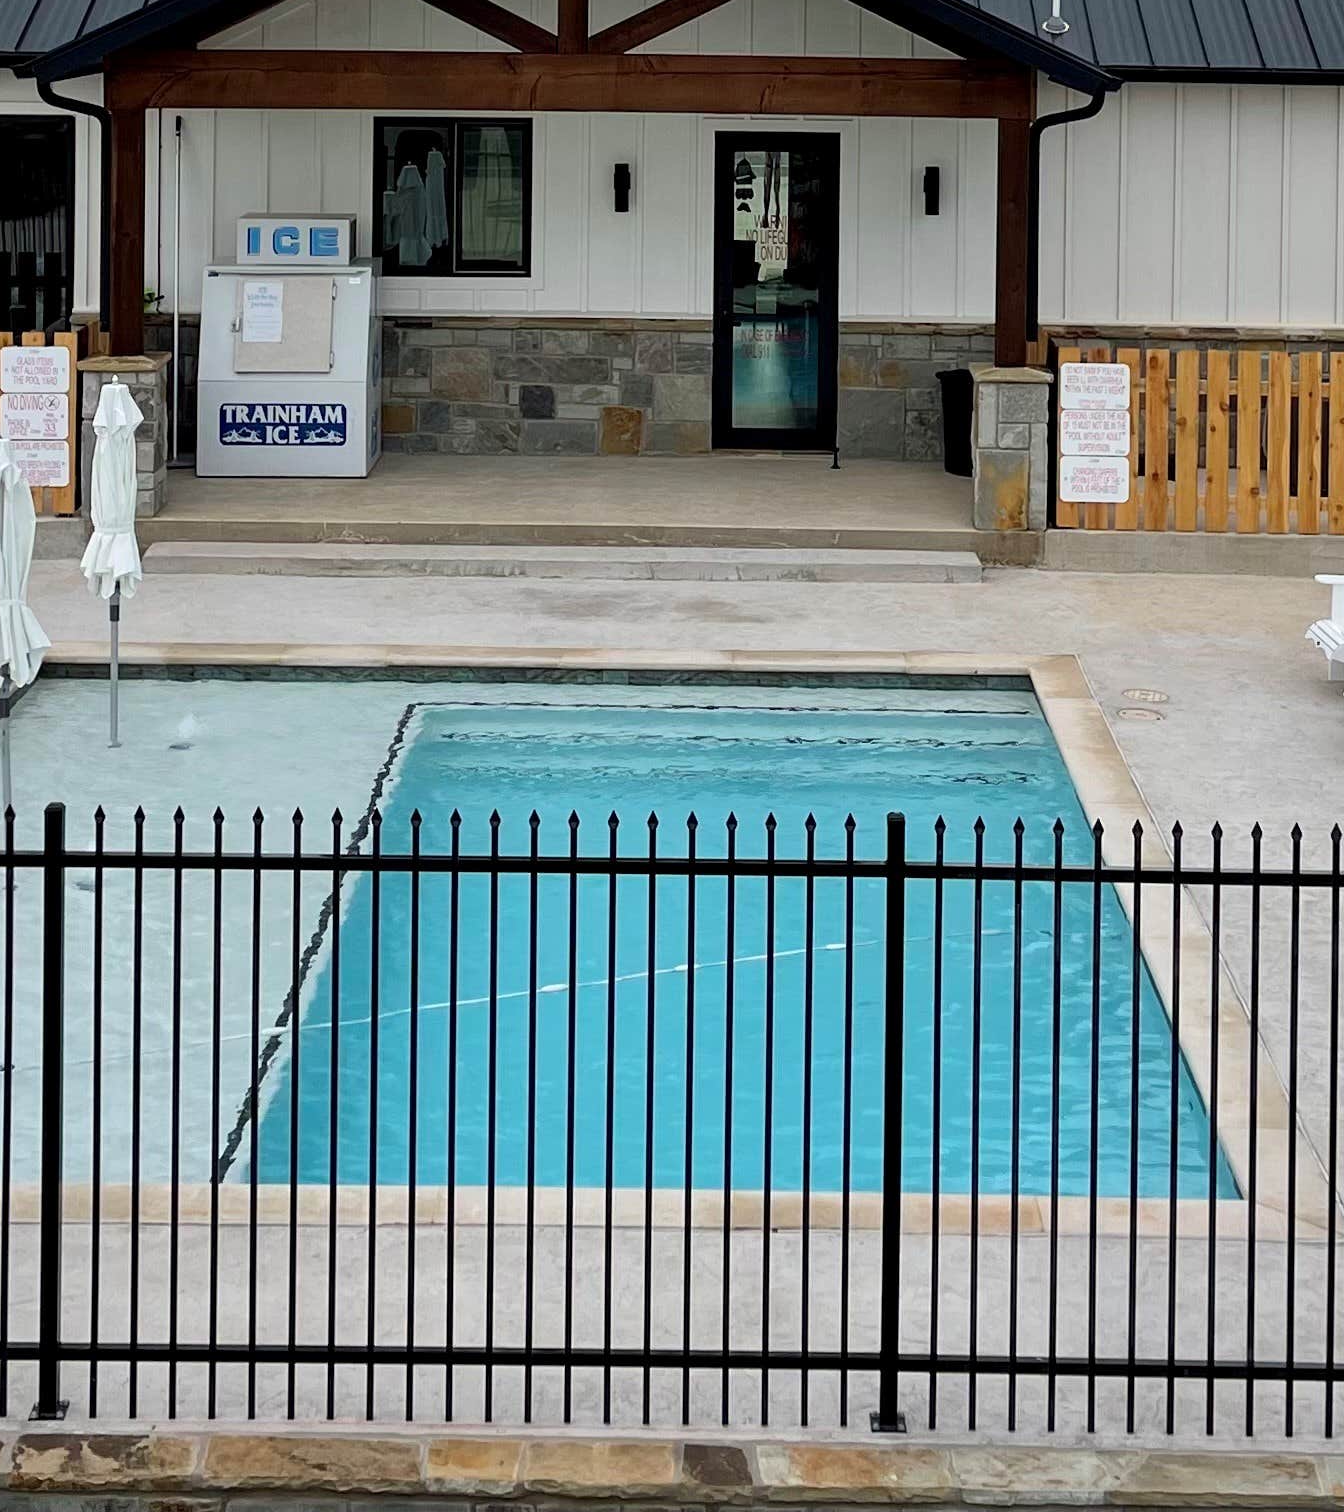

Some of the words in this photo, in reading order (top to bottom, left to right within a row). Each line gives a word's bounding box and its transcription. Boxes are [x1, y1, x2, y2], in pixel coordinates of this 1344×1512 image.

[754, 215, 789, 229] WARNI
[247, 226, 339, 256] ICE
[760, 229, 789, 245] LIFEGU
[775, 246, 789, 261] DU
[8, 394, 19, 411] NO
[20, 394, 44, 411] DIVING
[222, 405, 344, 424] TRAINHAM
[265, 425, 301, 445] ICE
